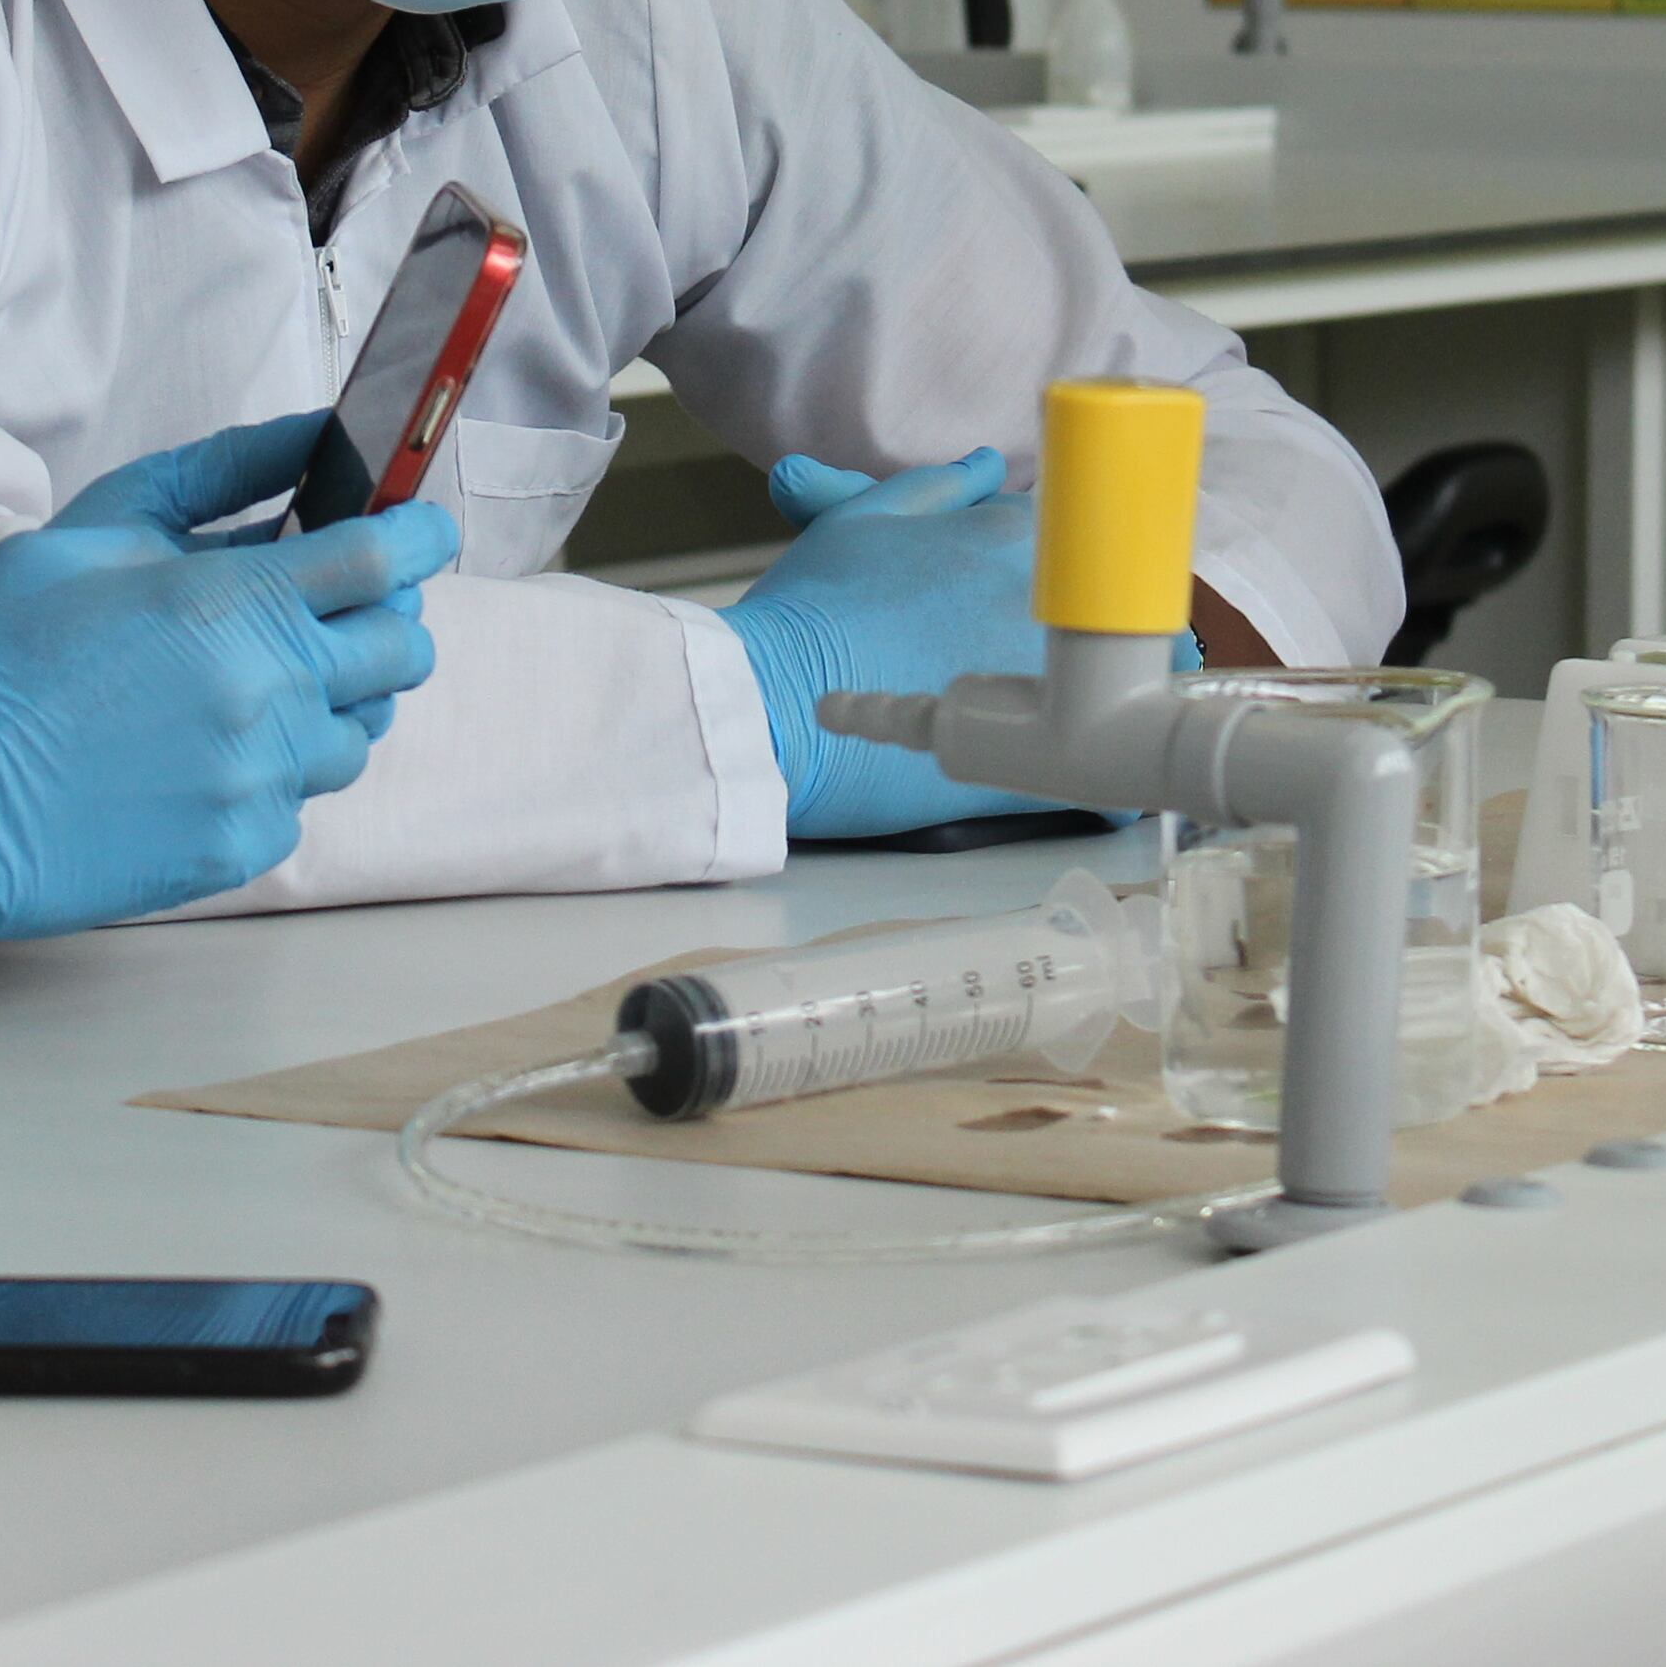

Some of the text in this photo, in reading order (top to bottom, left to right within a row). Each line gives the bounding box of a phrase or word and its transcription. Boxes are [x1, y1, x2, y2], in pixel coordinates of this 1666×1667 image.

[1016, 959, 1037, 990] 60
[1036, 954, 1057, 981] ml
[909, 979, 930, 1008] 40
[962, 969, 984, 999] 50
[800, 999, 823, 1030] 20
[855, 989, 878, 1018] 30
[745, 1010, 767, 1036] 10
